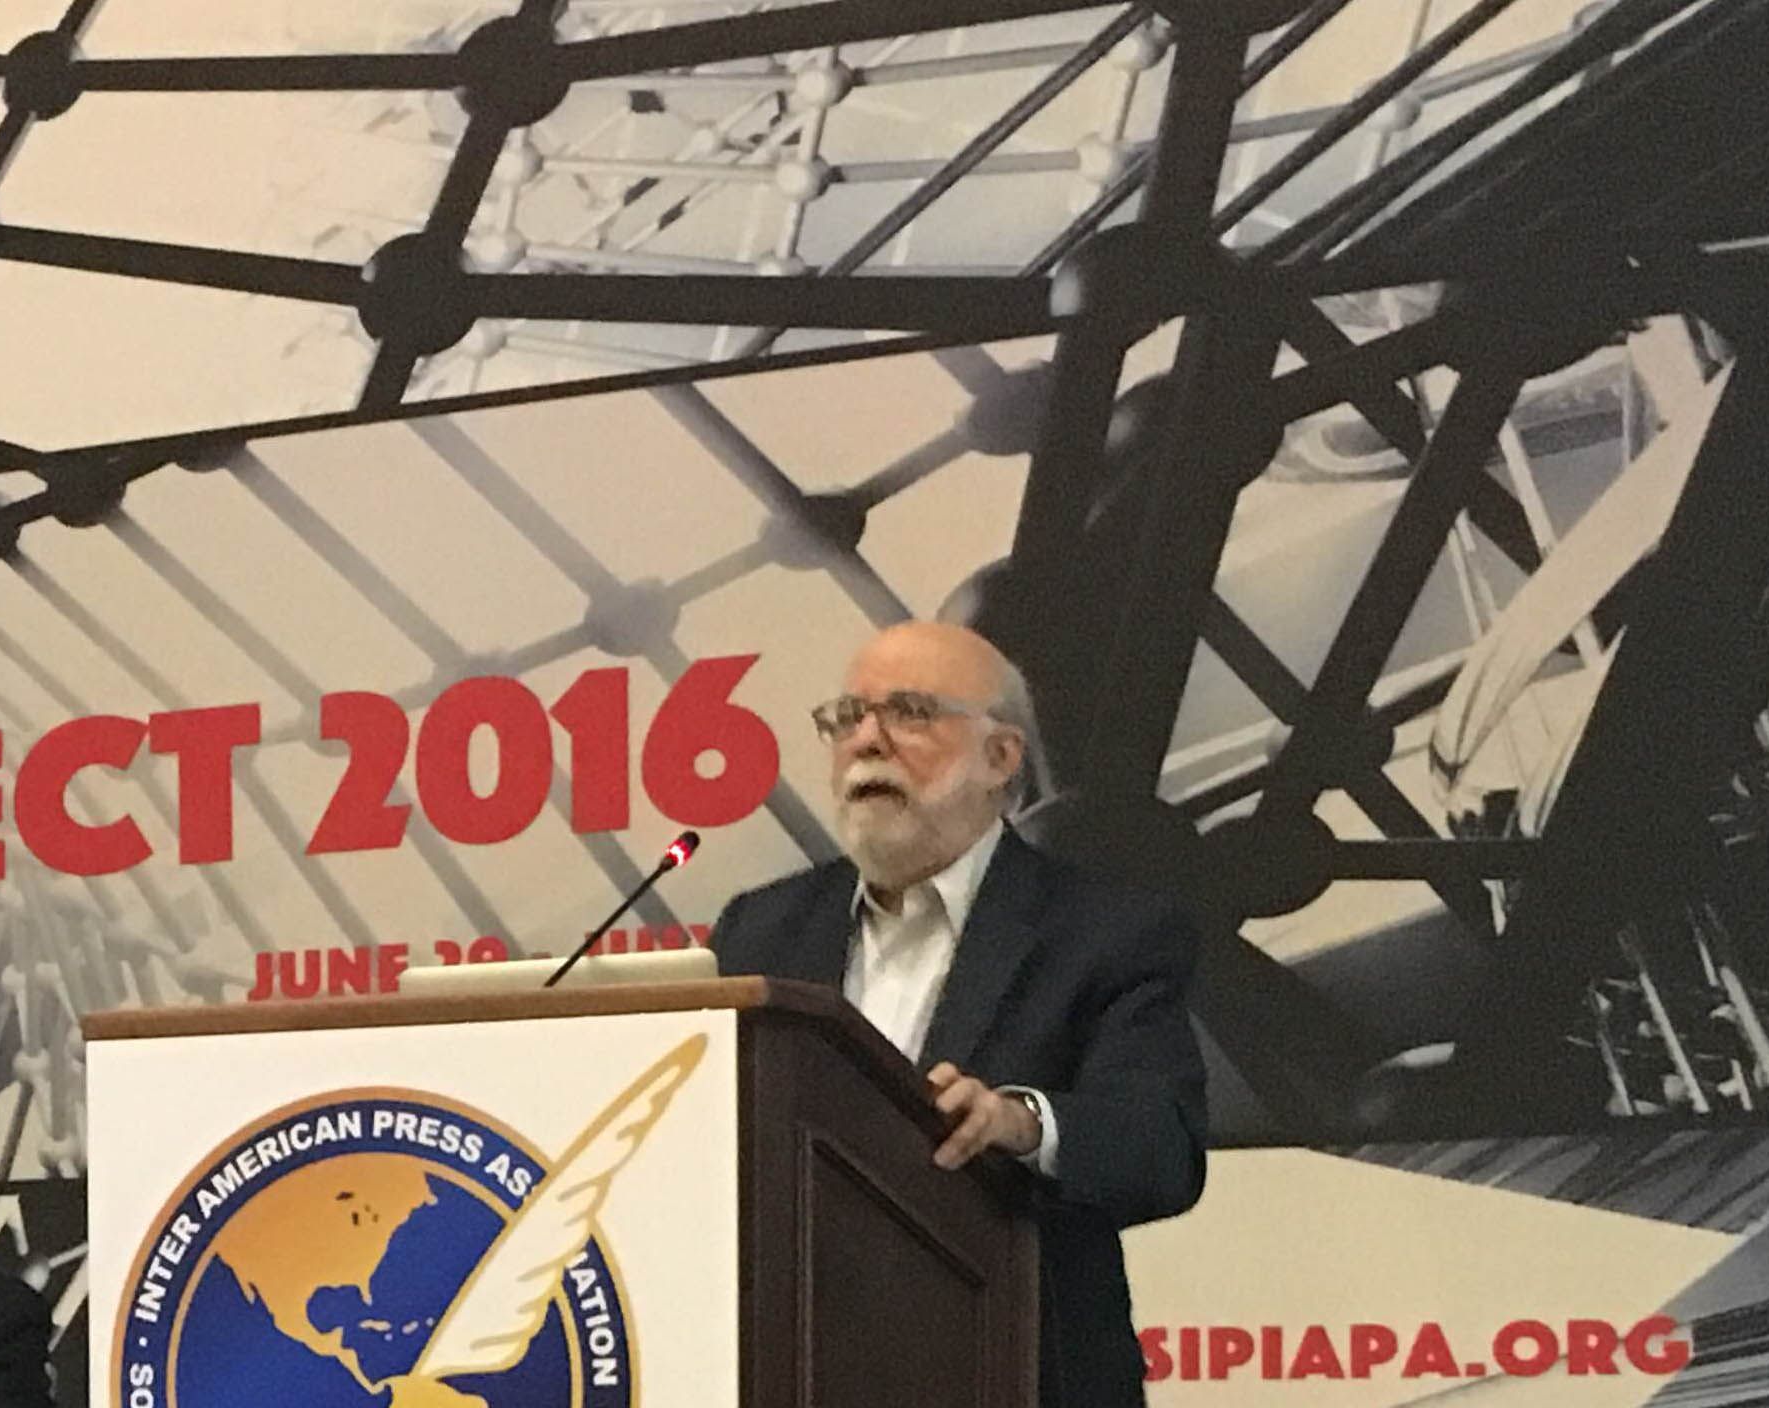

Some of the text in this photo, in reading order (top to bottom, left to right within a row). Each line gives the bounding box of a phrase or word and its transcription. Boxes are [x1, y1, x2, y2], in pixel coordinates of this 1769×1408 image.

[306, 654, 781, 855] 2016
[248, 943, 410, 1001] JUNE
[134, 1217, 201, 1325] INTER
[197, 1111, 363, 1219] AMERICAN
[372, 1109, 484, 1163] PRESS
